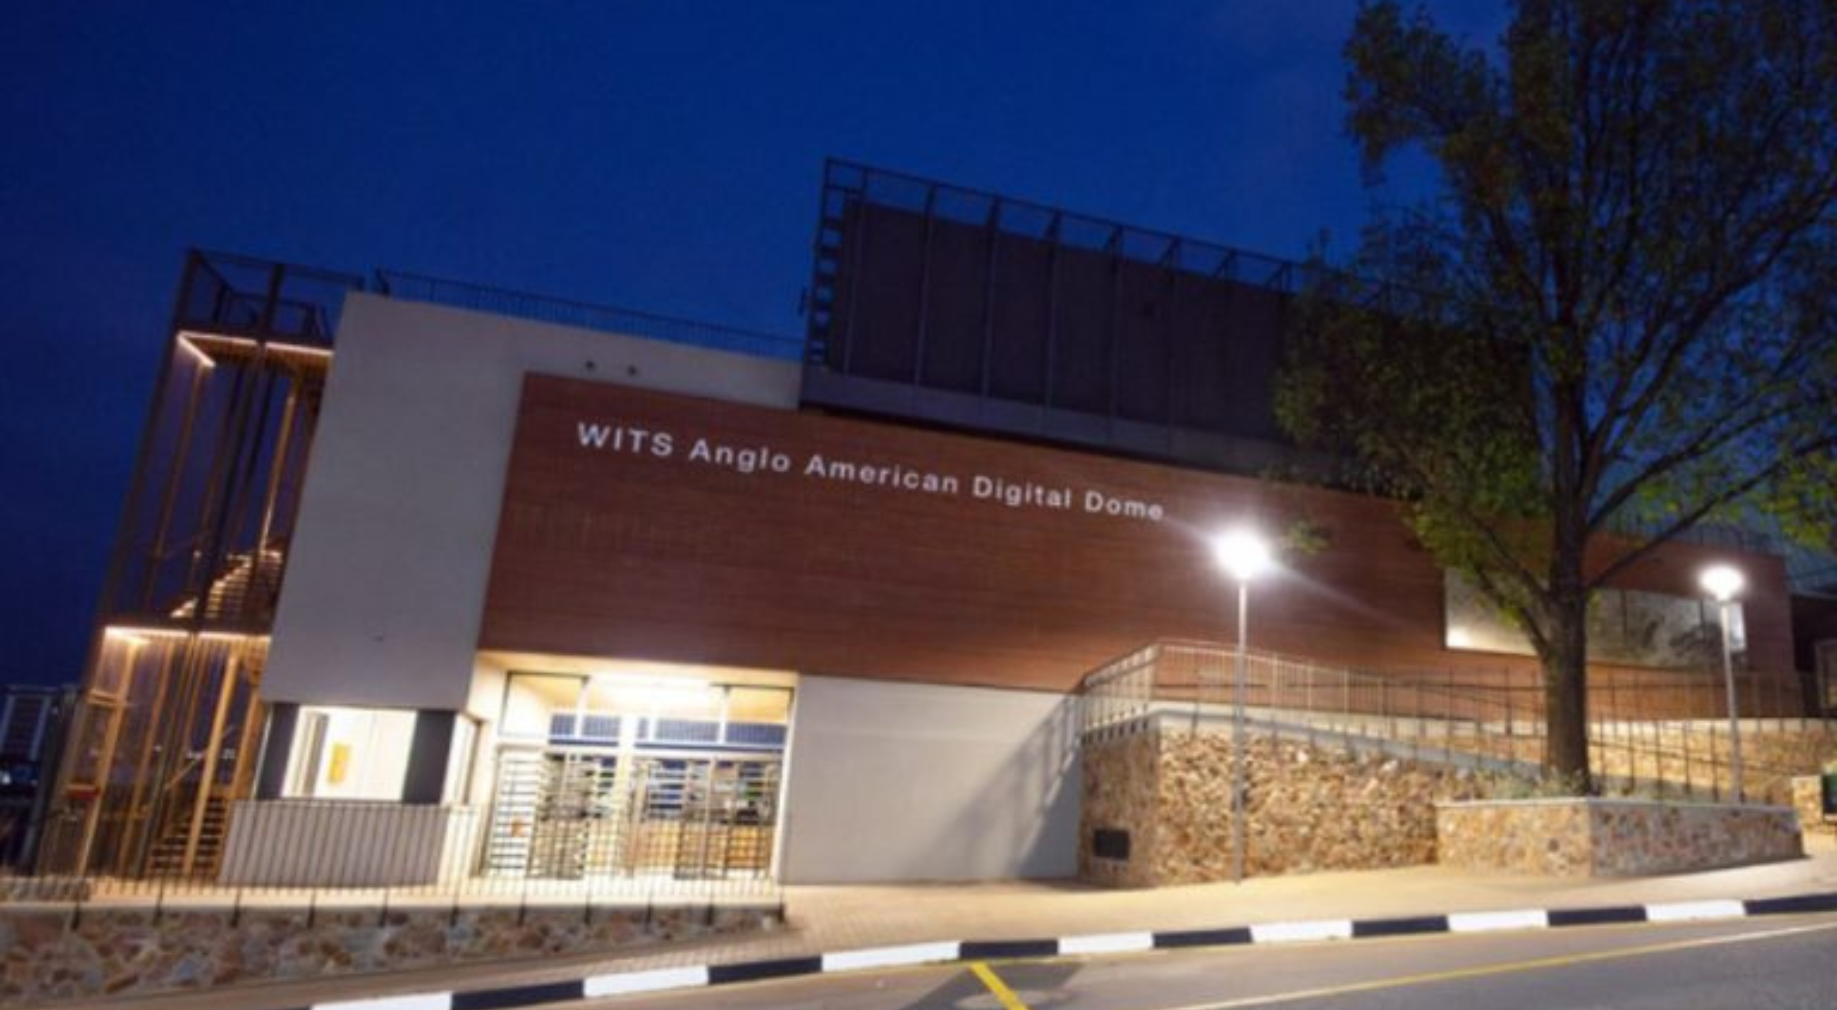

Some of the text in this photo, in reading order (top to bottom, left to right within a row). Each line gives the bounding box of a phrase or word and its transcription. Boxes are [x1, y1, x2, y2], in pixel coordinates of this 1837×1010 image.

[577, 422, 1164, 520] WITS Anglo American Digital Dome
